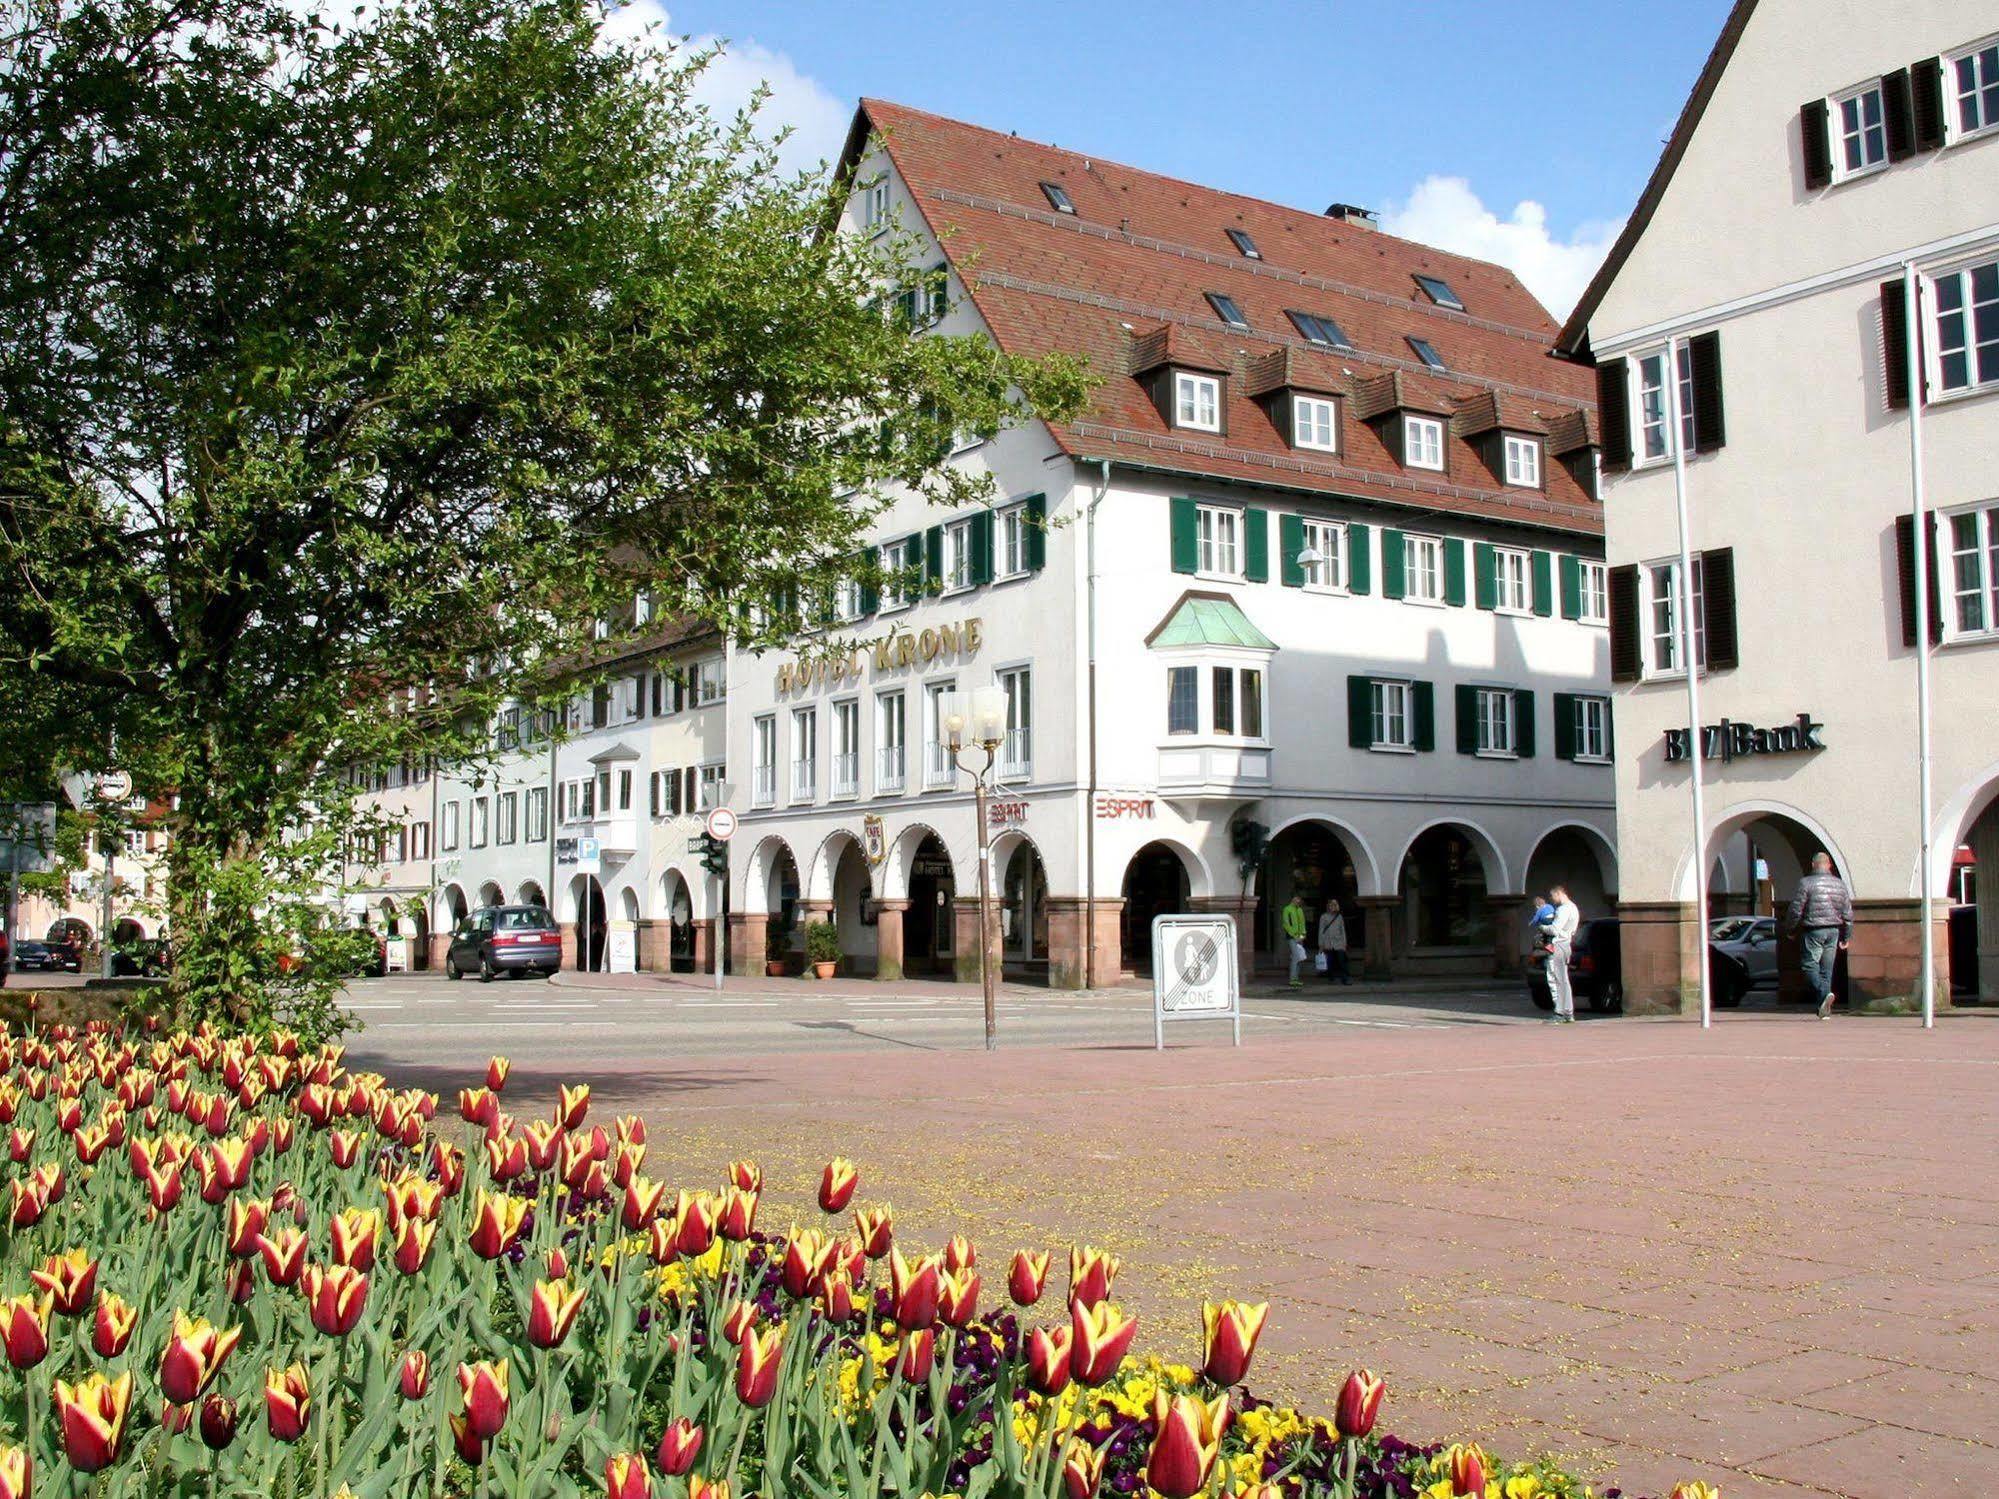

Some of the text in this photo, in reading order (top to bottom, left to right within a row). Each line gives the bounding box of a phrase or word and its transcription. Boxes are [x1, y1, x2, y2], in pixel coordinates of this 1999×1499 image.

[777, 617, 984, 692] HOTEL KRONE
[991, 802, 1031, 823] ESPRIT
[1096, 799, 1155, 819] ESPRIT
[582, 840, 595, 858] P
[1181, 990, 1215, 1006] ZONE
